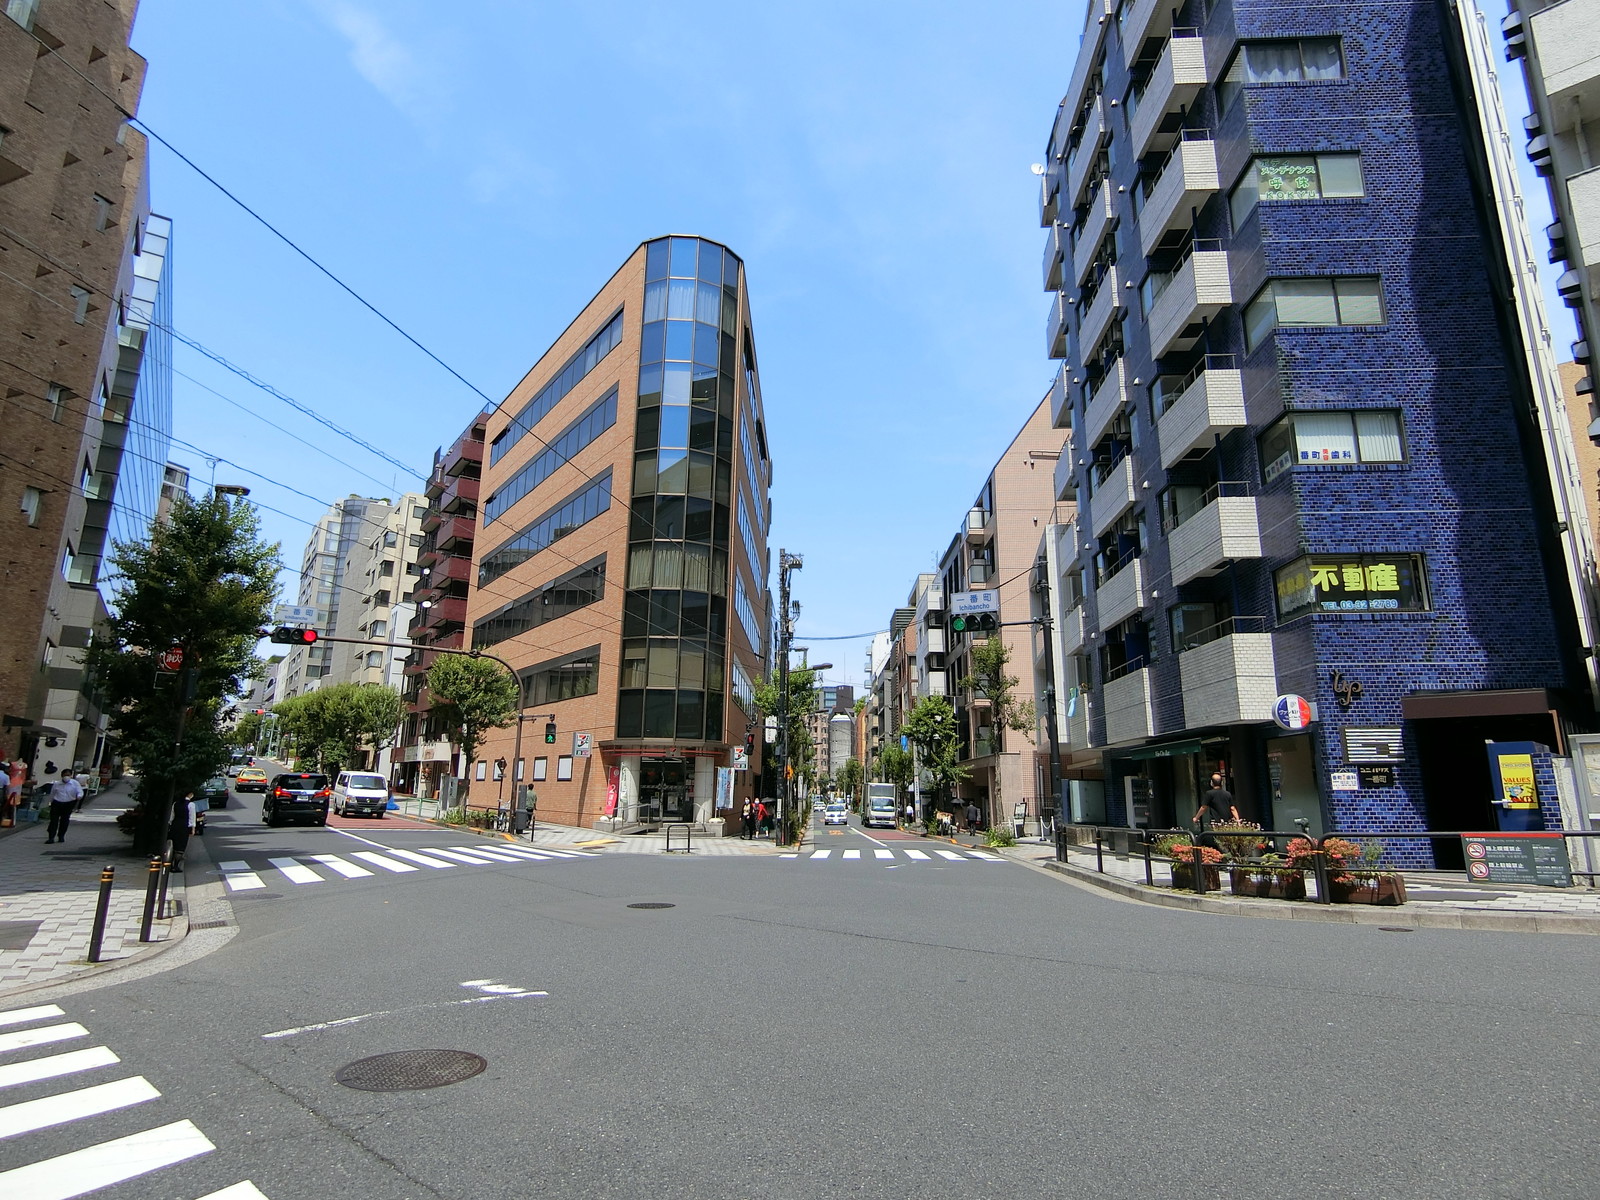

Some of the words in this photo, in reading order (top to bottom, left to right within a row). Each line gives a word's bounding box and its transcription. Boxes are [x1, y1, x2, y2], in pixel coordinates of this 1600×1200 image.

[1261, 166, 1315, 175] メンテナンス
[1266, 190, 1316, 199] KOKYU
[1309, 563, 1400, 592] 不動産
[956, 593, 991, 603] 一番町
[959, 603, 990, 611] Ichibancho
